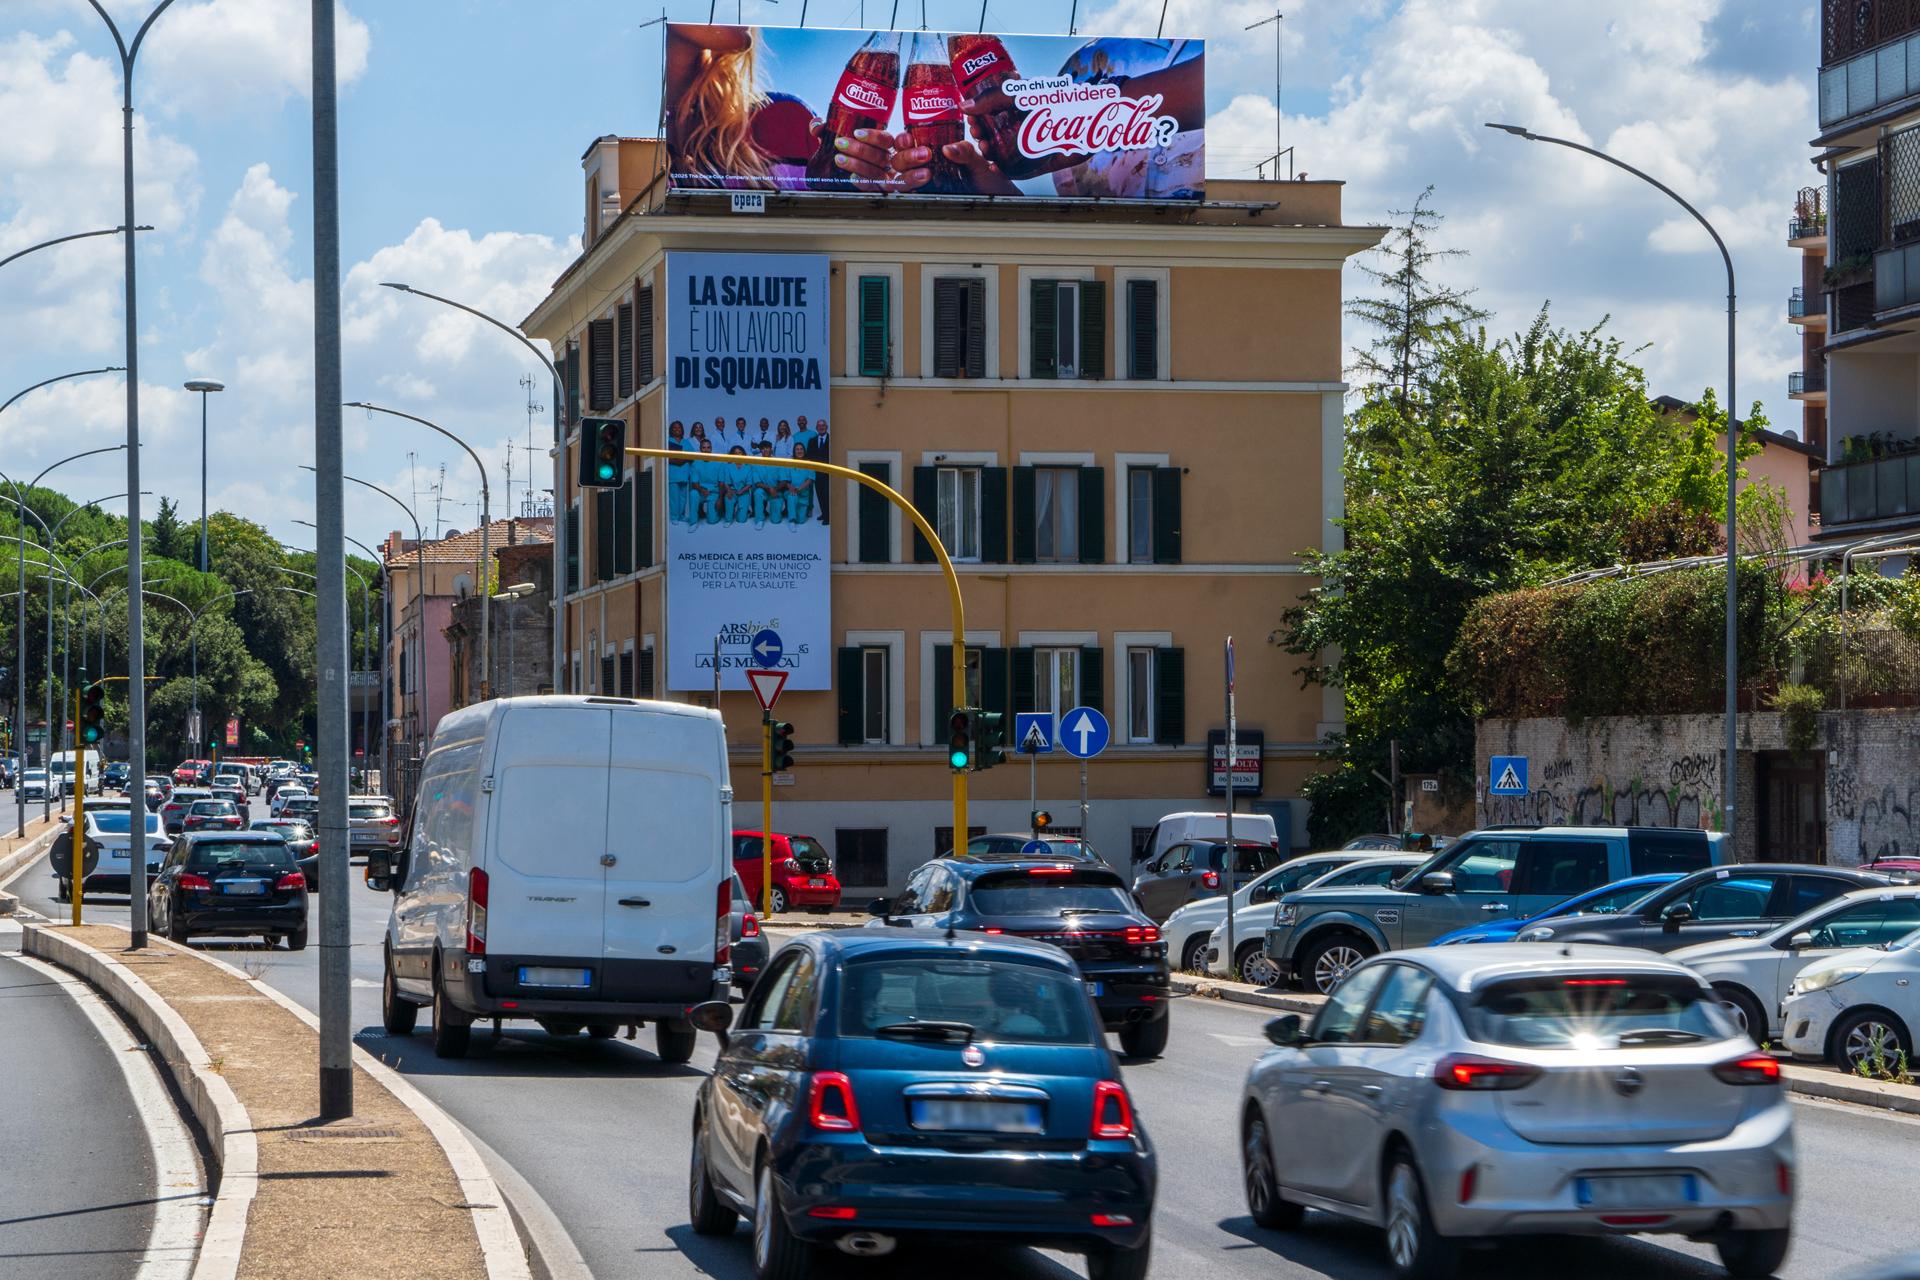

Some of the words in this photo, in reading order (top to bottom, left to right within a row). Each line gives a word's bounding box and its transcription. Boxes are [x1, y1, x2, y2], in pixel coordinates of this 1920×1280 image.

[964, 52, 997, 75] Best
[1006, 83, 1027, 93] Con
[1029, 80, 1045, 91] chi
[1047, 78, 1069, 89] vuoi
[846, 84, 885, 107] Giulia
[1019, 87, 1117, 107] condividere
[911, 97, 954, 110] Matteo
[734, 194, 762, 210] opera
[689, 275, 718, 306] LA
[721, 276, 807, 307] SALUTE
[690, 306, 700, 353] È
[705, 310, 730, 353] UN
[736, 311, 806, 354] LAVORO
[675, 356, 700, 389] DI
[704, 356, 822, 396] SQUADRA
[678, 553, 697, 561] ARS
[699, 553, 735, 561] MEDICA
[738, 553, 743, 561] E
[745, 553, 764, 561] ARS
[766, 553, 821, 561] BIOMEDICA.
[689, 562, 710, 570] DUE
[712, 562, 760, 572] CLINICHE,
[692, 571, 727, 579] PUNTO
[729, 572, 739, 580] DI
[741, 572, 807, 580] RIFERIMENTO
[702, 581, 721, 589] PER
[724, 581, 735, 589] LA
[738, 581, 757, 589] TUA
[759, 581, 799, 589] SALUTE.
[701, 657, 732, 668] AS
[735, 657, 794, 668] MECA
